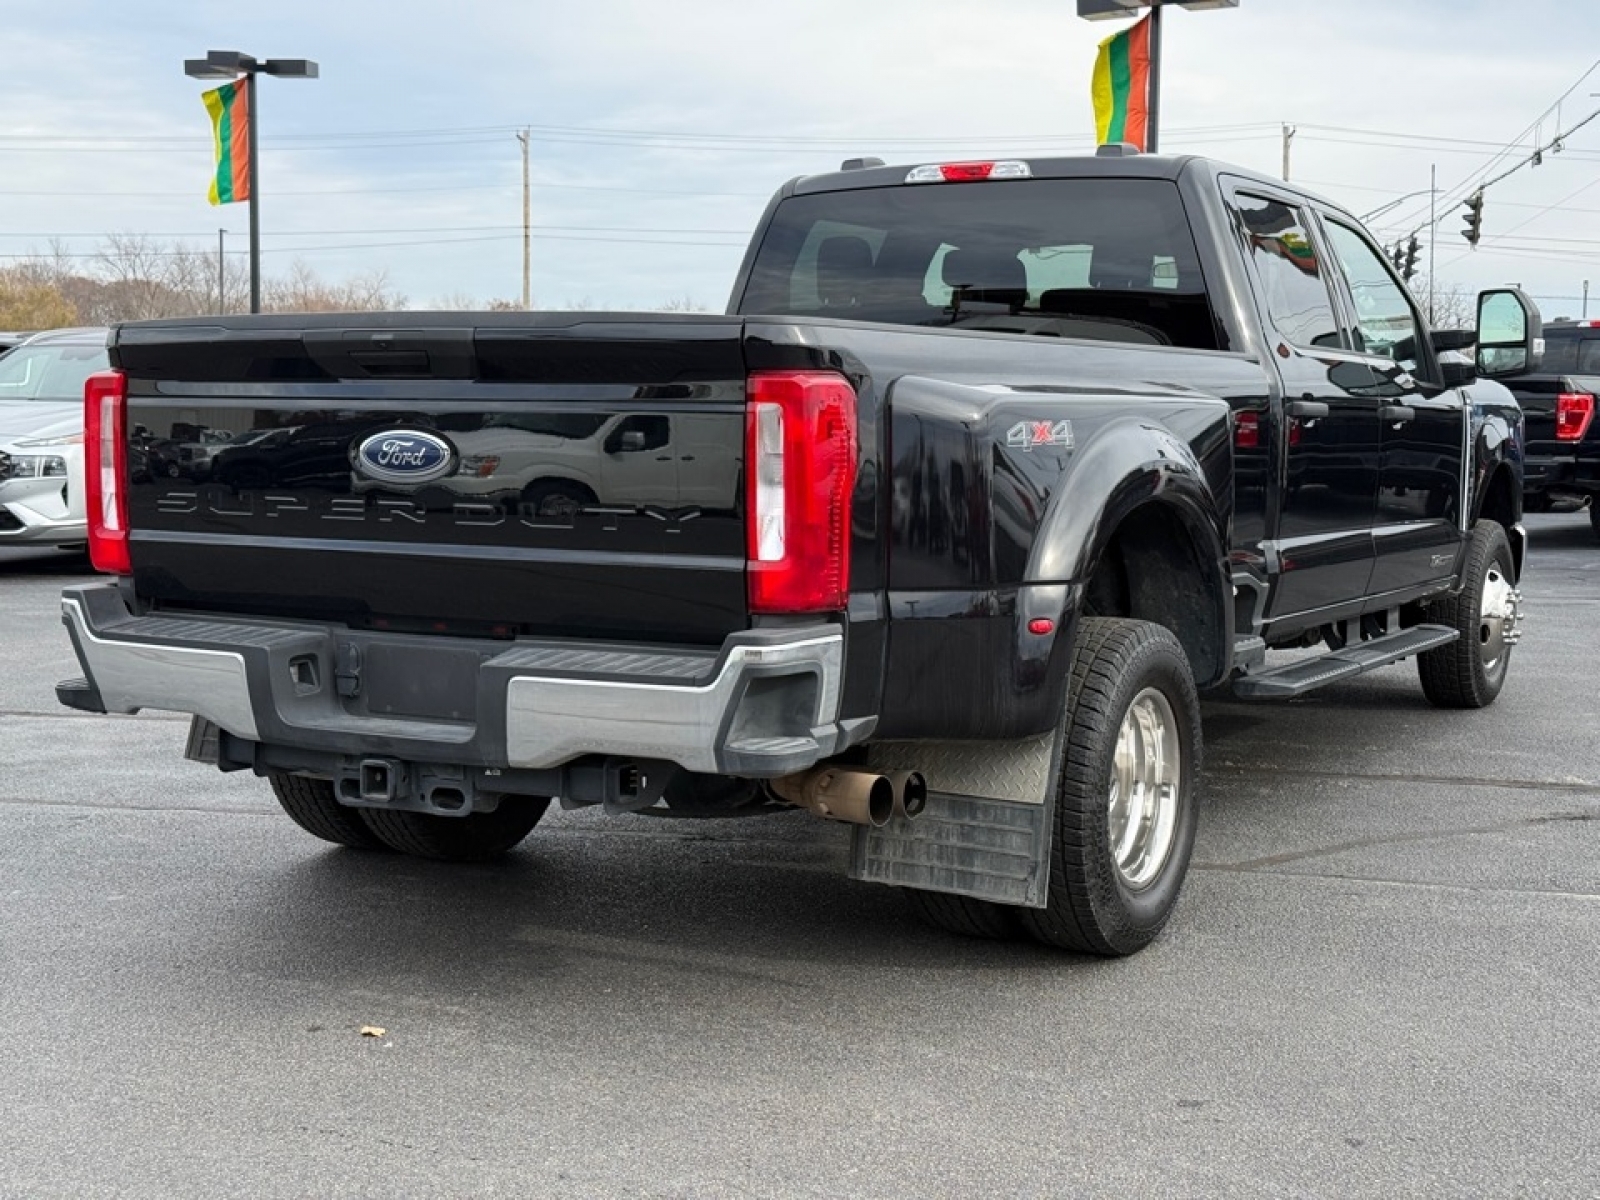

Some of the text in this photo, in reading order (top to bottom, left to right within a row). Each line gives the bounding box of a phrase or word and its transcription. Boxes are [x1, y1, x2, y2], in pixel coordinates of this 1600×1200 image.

[378, 439, 426, 466] Ford
[156, 491, 701, 534] SUPER DUTY
